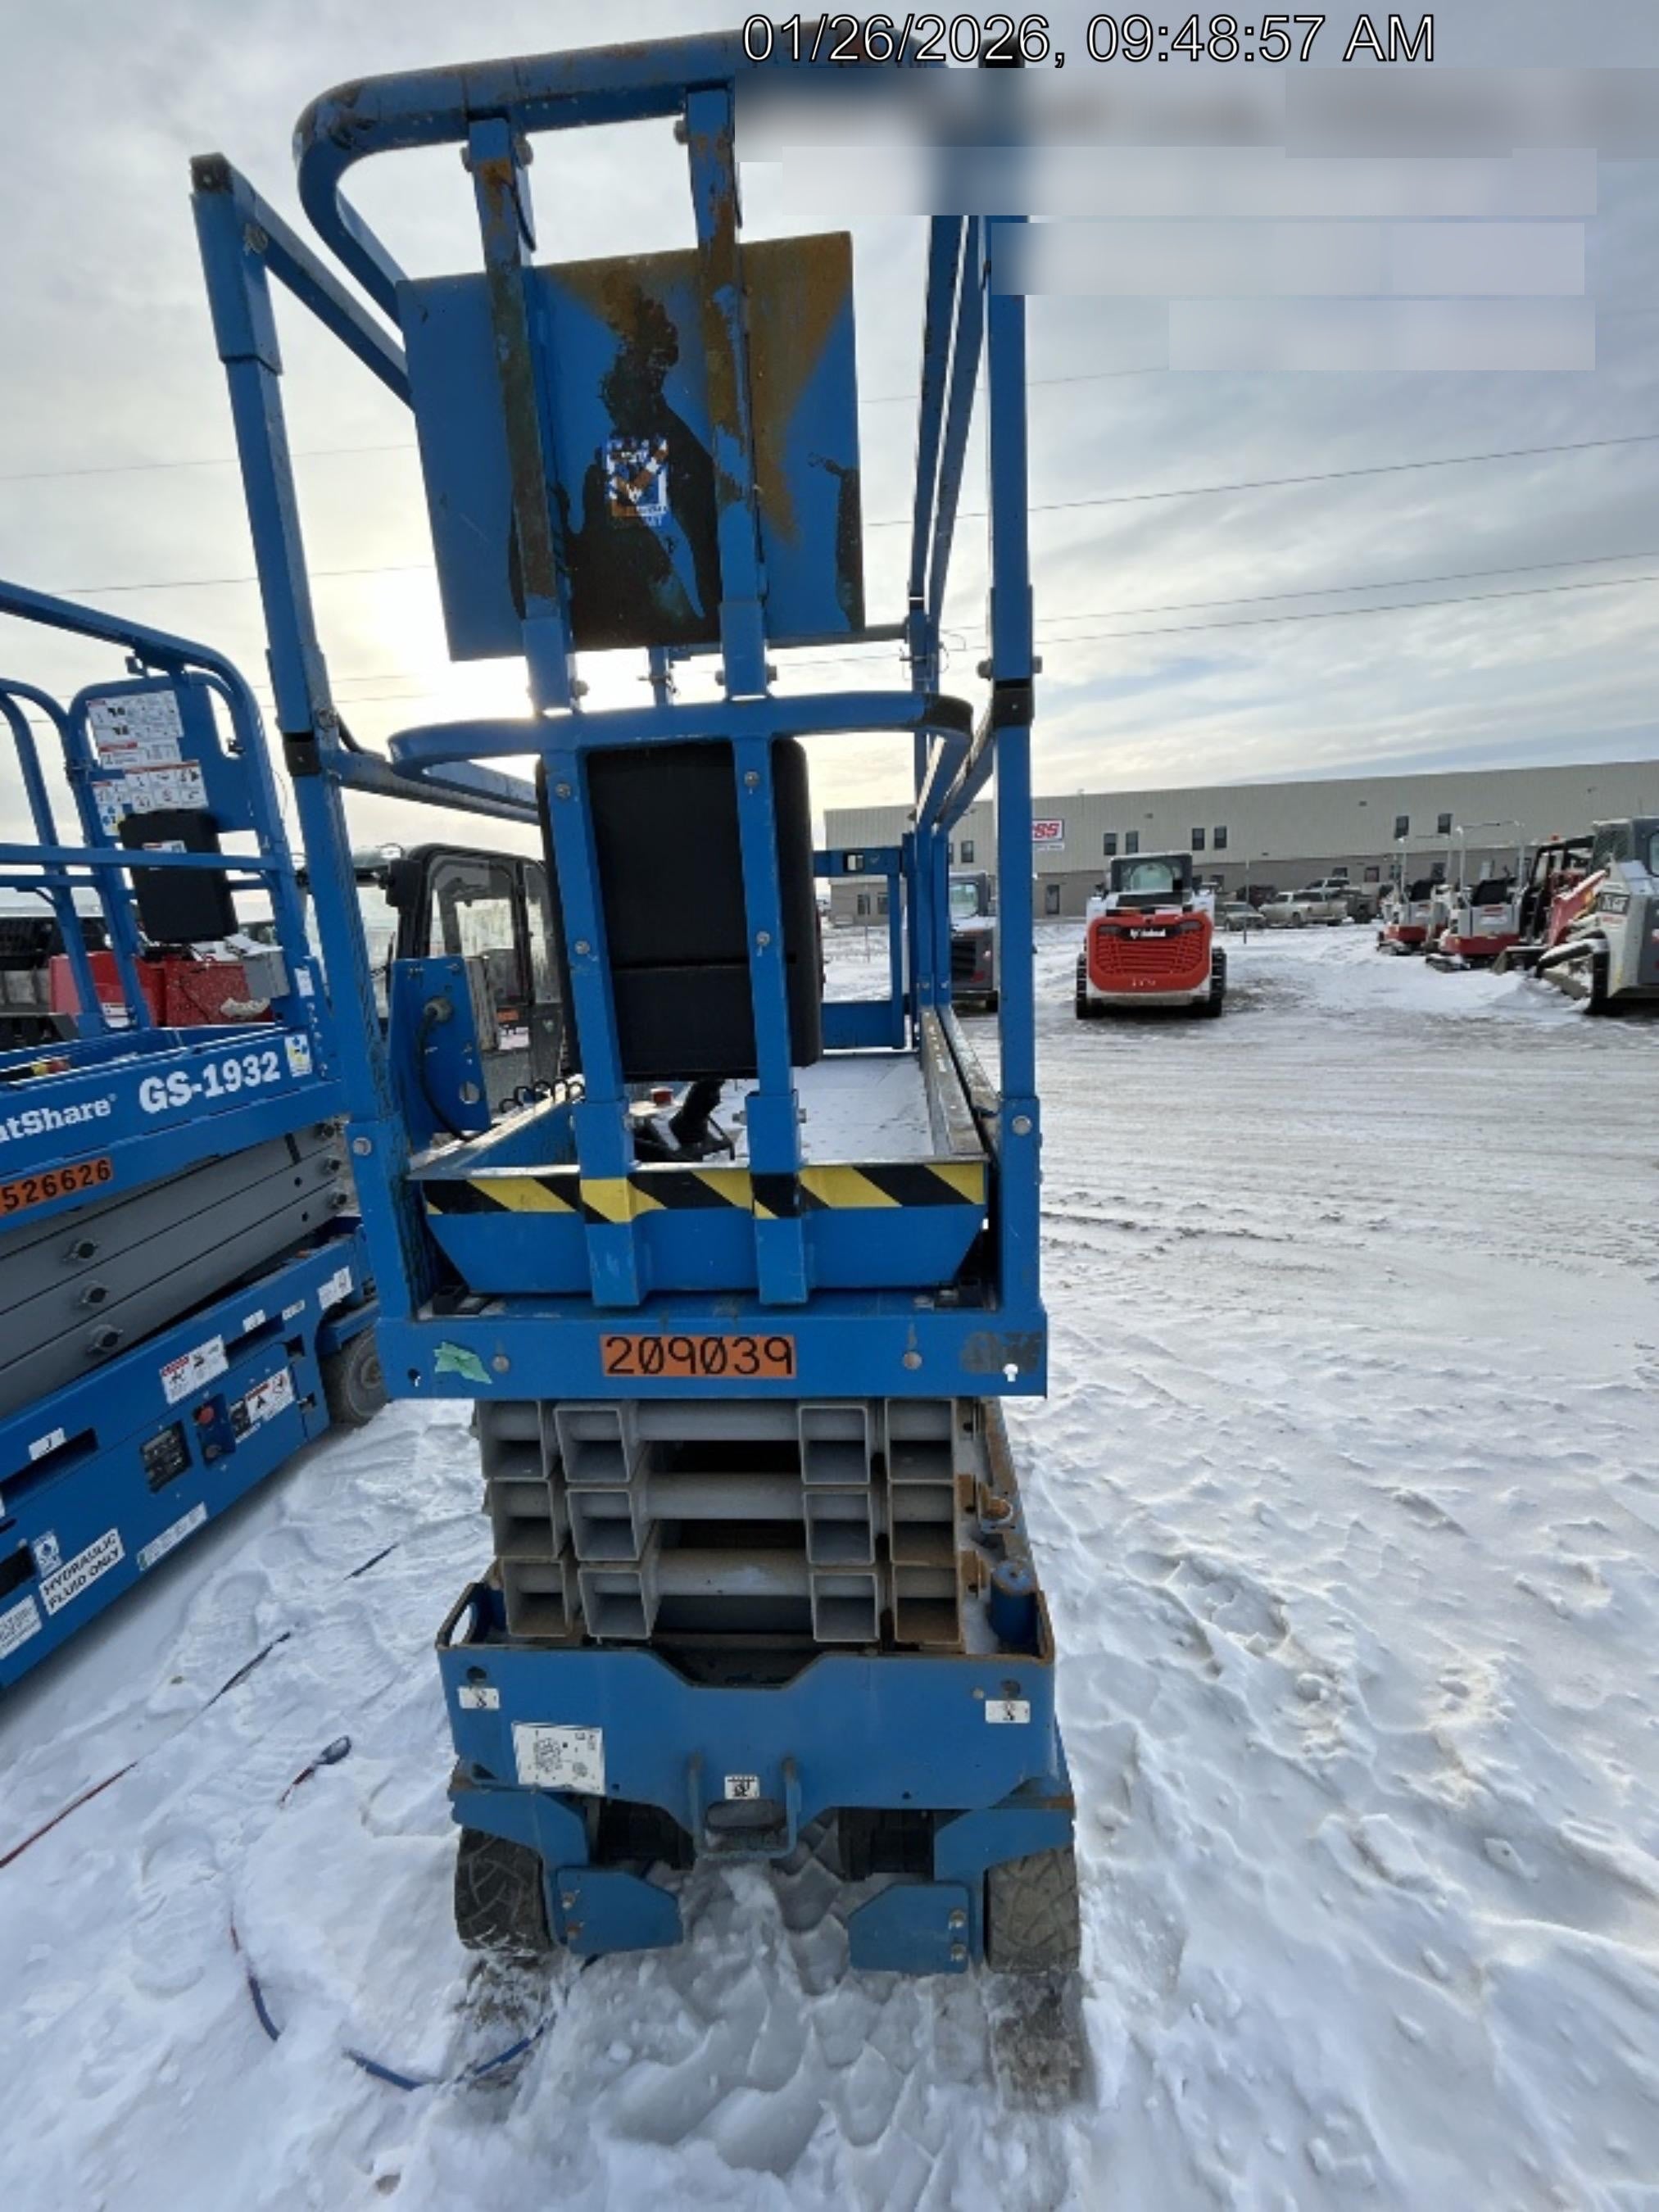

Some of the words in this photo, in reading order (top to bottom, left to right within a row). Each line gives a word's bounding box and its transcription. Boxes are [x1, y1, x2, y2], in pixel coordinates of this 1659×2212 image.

[1032, 823, 1059, 838] SS
[139, 1050, 281, 1114] GS-1932
[1, 1159, 111, 1210] 526626
[606, 1336, 792, 1374] 209039
[43, 1532, 116, 1596] HYDRAULIC
[48, 1575, 87, 1609] FLUID
[88, 1547, 119, 1576] ONLY
